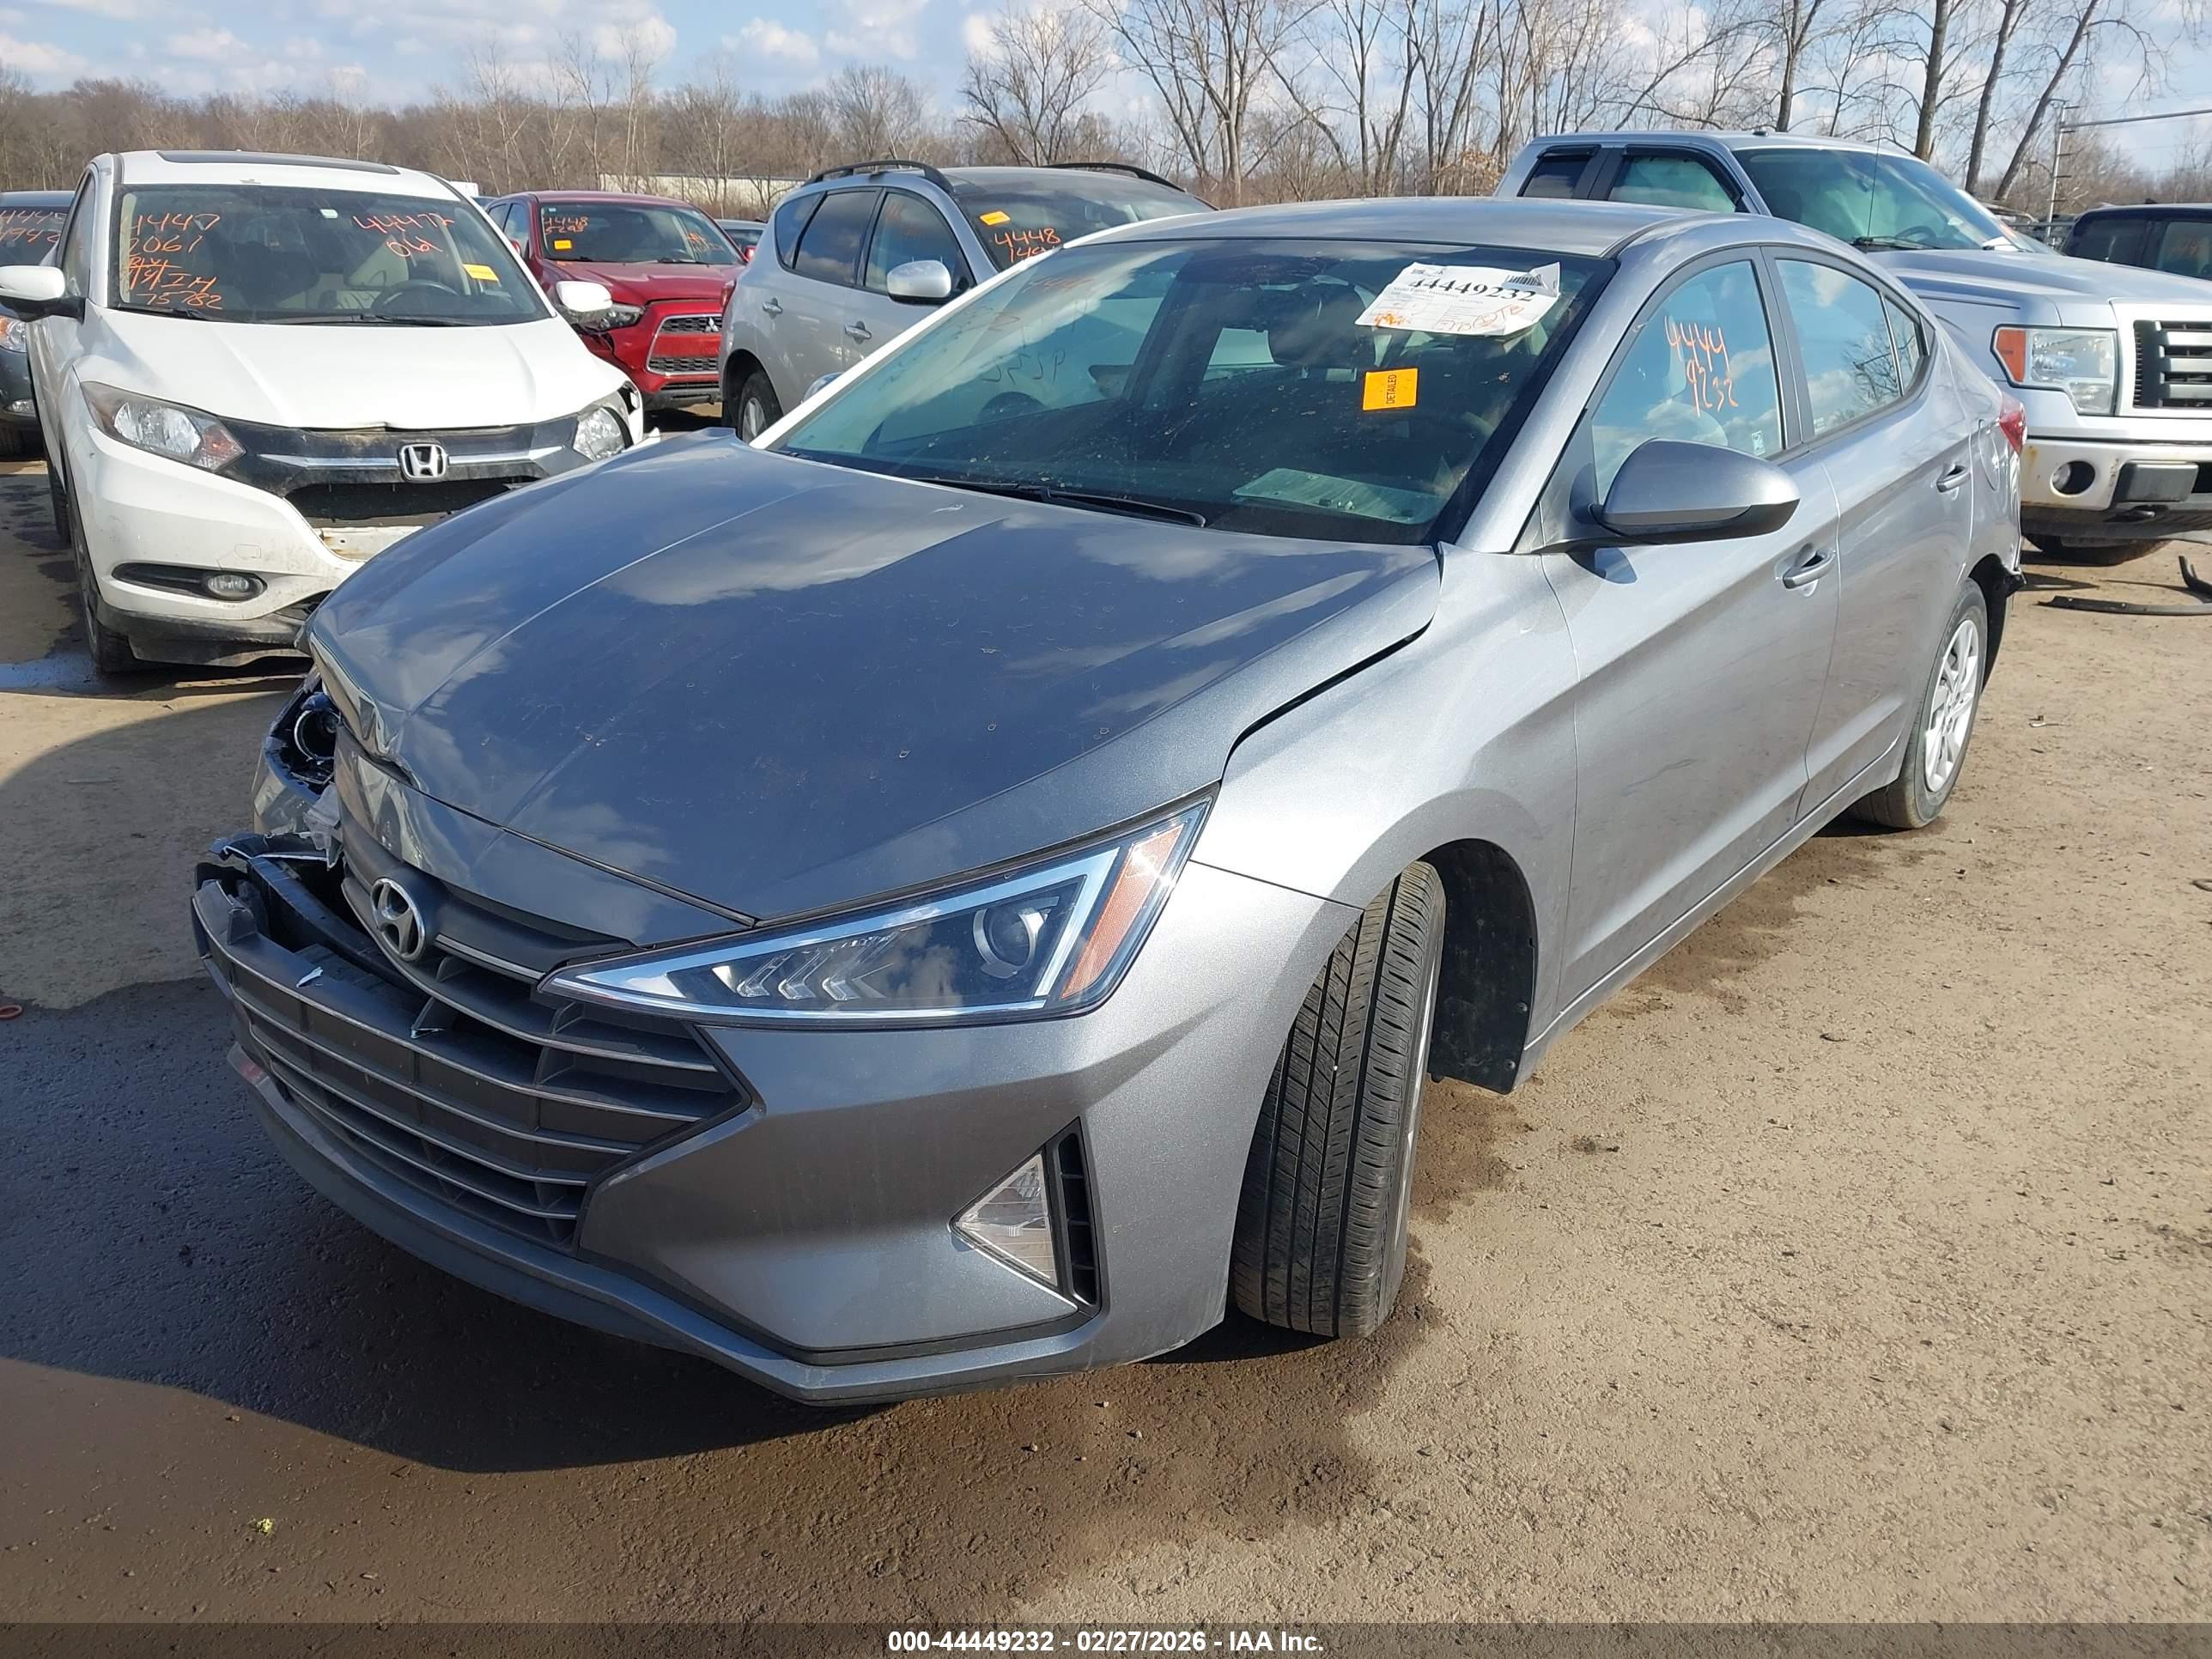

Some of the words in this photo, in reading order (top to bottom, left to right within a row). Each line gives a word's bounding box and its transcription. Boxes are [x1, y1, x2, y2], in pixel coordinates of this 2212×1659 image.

[994, 228, 1061, 248] 4448
[1408, 277, 1537, 302] 44449232
[1664, 315, 1731, 372] 4444
[1386, 374, 1397, 404] DETAILED
